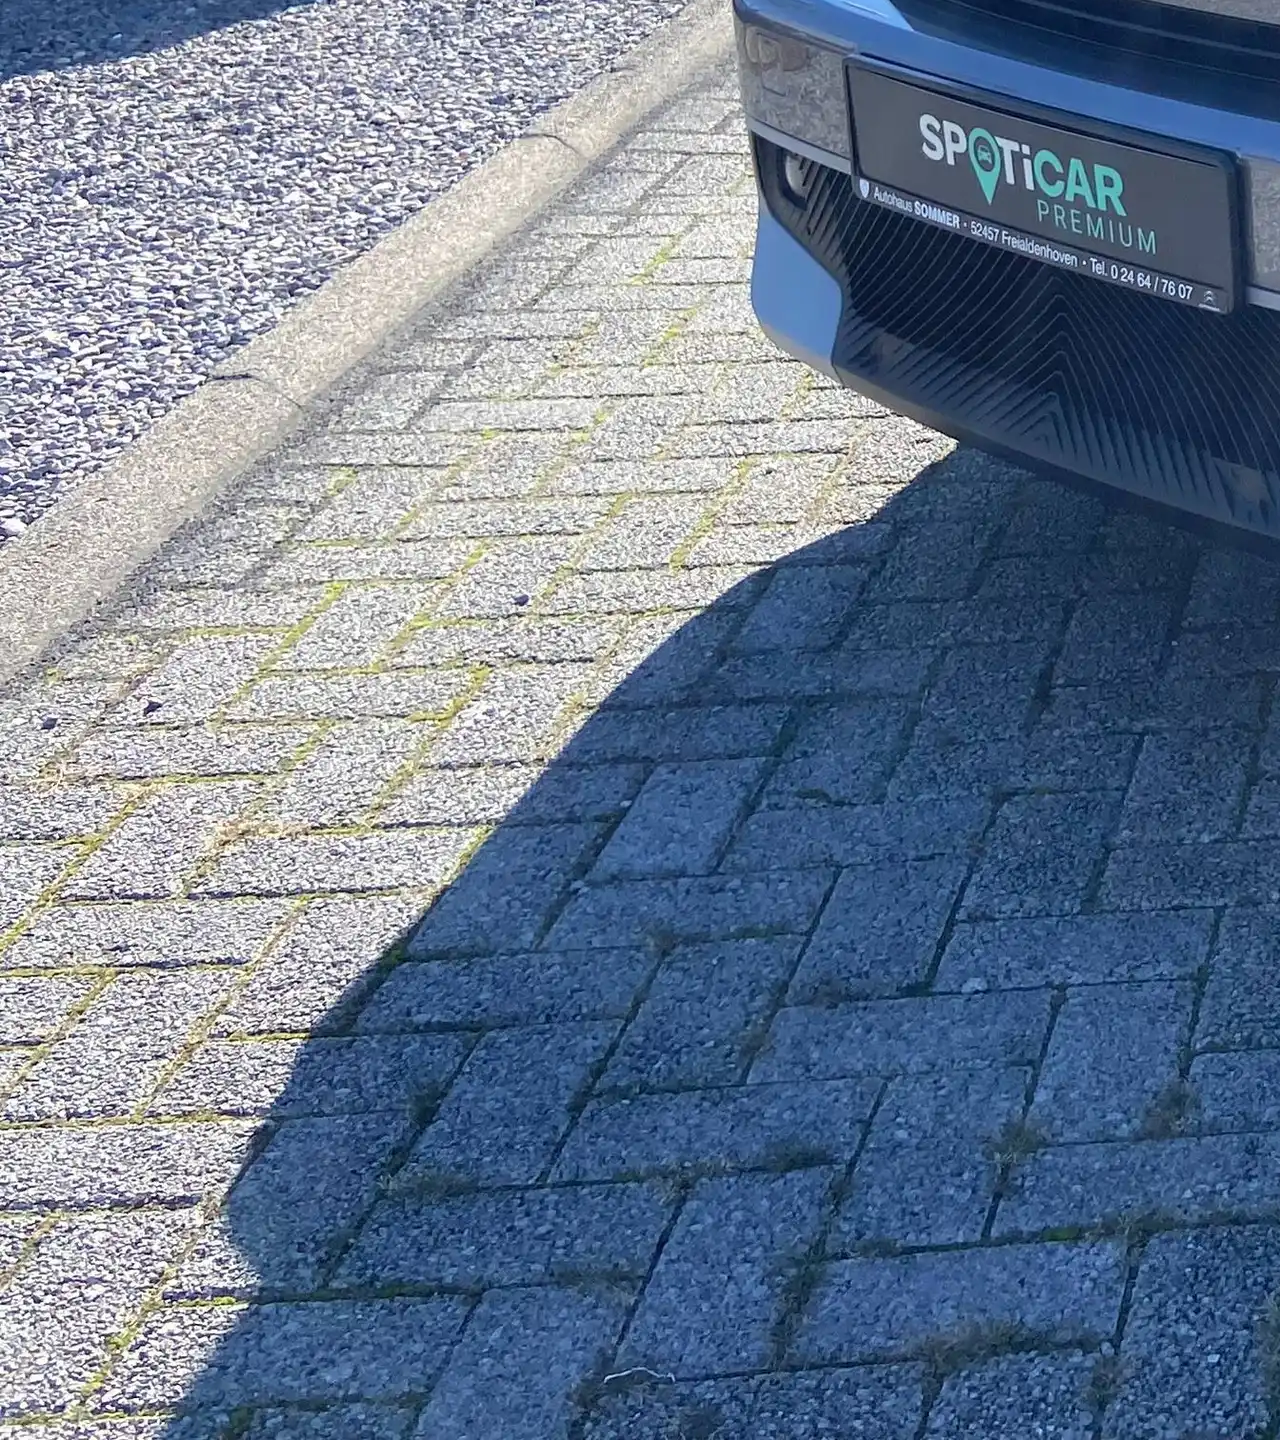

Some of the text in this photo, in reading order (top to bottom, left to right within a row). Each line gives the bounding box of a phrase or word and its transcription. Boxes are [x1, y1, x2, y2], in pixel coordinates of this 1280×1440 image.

[874, 186, 914, 213] Autohaus
[914, 200, 961, 229] SOMMER
[970, 221, 1000, 242] 52457
[1001, 231, 1078, 267] Freialdenhoven
[1090, 257, 1109, 276] Tel.
[1110, 265, 1118, 279] 0
[1120, 267, 1135, 284] 24
[1137, 272, 1152, 289] 64
[1161, 279, 1176, 296] 76
[1178, 285, 1193, 300] 07
[1036, 199, 1157, 255] PREMIUM
